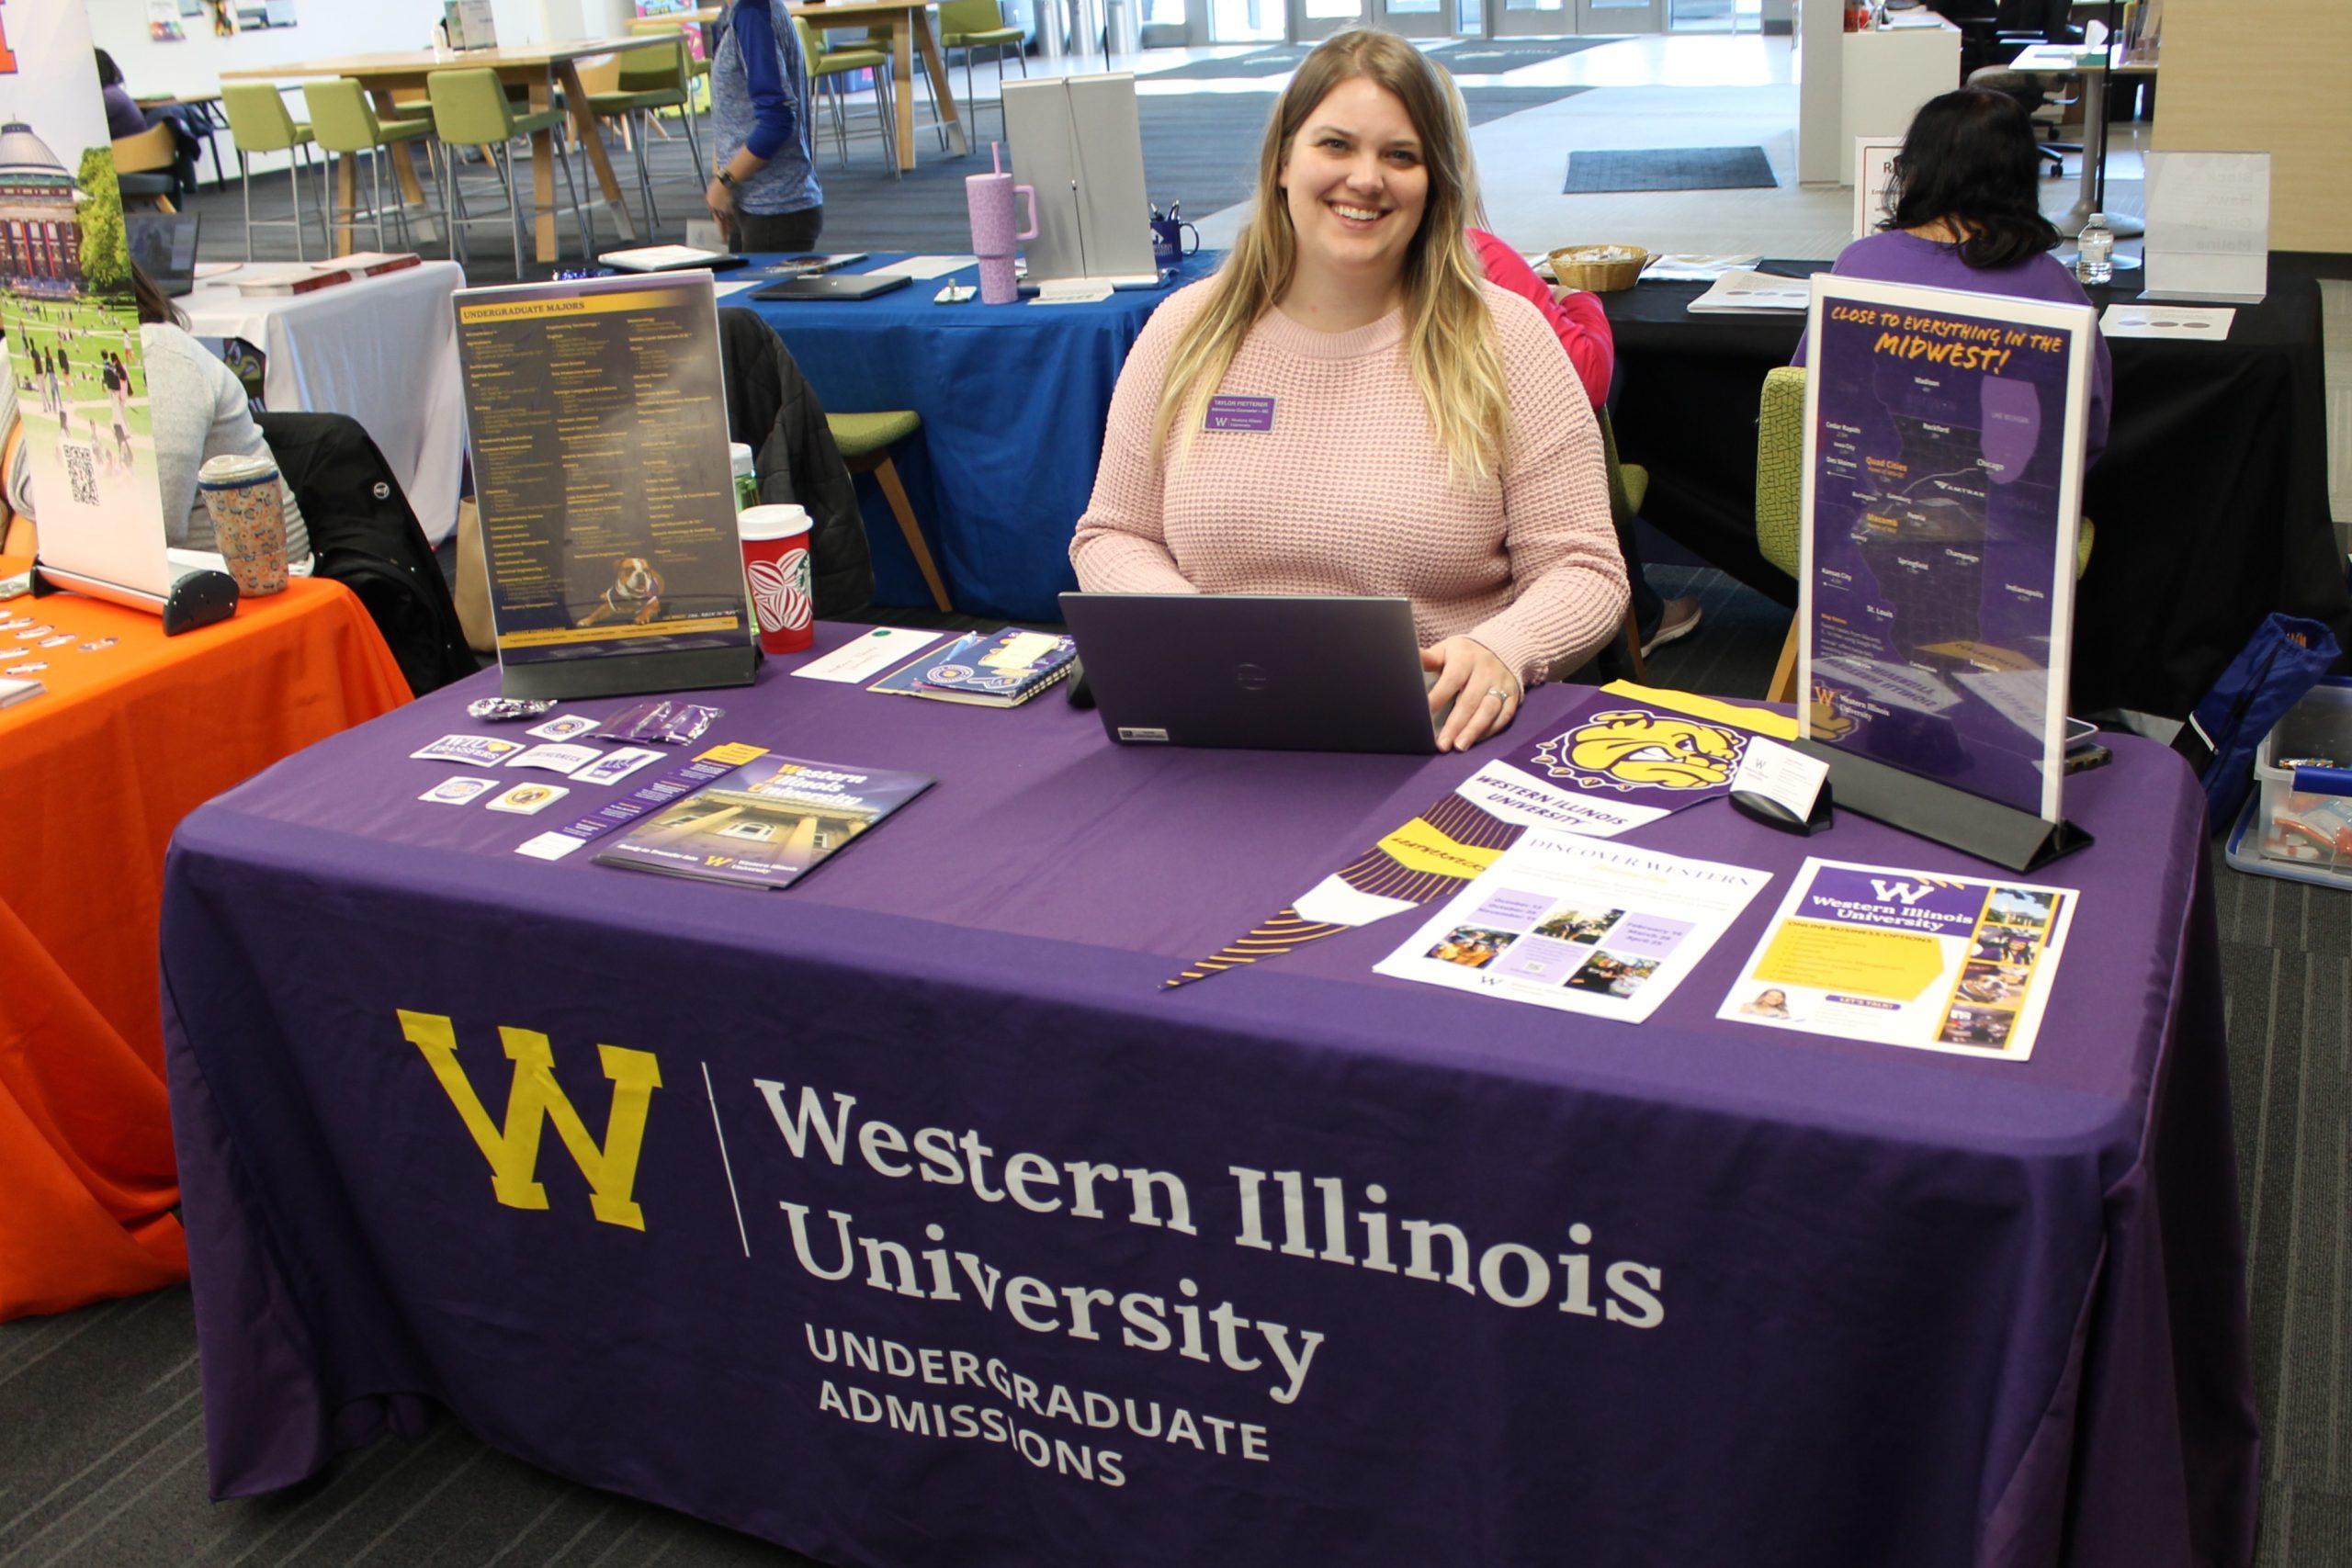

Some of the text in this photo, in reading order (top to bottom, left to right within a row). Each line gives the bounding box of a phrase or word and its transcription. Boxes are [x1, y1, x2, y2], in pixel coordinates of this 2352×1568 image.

[463, 301, 585, 320] UNDERGRADUATE MAJORS
[1831, 306, 2064, 353] CLOSE TO EVERYTHING IN THE
[1873, 332, 2011, 375] MIDWEST!
[1215, 416, 1228, 427] W
[1922, 422, 1951, 434] Rockford
[1865, 456, 1908, 472] Quad Cities
[1976, 458, 2005, 472] Chicago
[1947, 485, 1985, 498] AMTRAK
[1876, 607, 1894, 618] Louis
[1815, 685, 1837, 706] W
[1839, 694, 1891, 717] Western Illinois
[432, 744, 500, 761] TRANSFERS
[445, 736, 486, 750] WIU
[764, 773, 845, 793] Illinois
[778, 763, 867, 784] Western
[747, 783, 864, 807] University
[1476, 775, 1629, 826] WESTERN ILLINOIS
[1487, 793, 1588, 826] UNIVERSITY
[704, 855, 734, 867] W
[1530, 837, 1640, 867] DISCOVER
[1645, 860, 1749, 887] WESTERN
[1870, 878, 1935, 905] W
[1812, 895, 1973, 926] Western Illinois
[1837, 908, 1945, 932] University
[1787, 920, 1933, 944] ONLINE BUSINESS OPTIONS
[1480, 975, 1504, 986] W
[396, 1009, 662, 1232] W
[753, 1078, 1664, 1328] Western Illinois
[779, 1201, 1324, 1404] University
[805, 1323, 1270, 1461] UNDERGRADUATE
[820, 1380, 1125, 1486] ADMISSIONS
